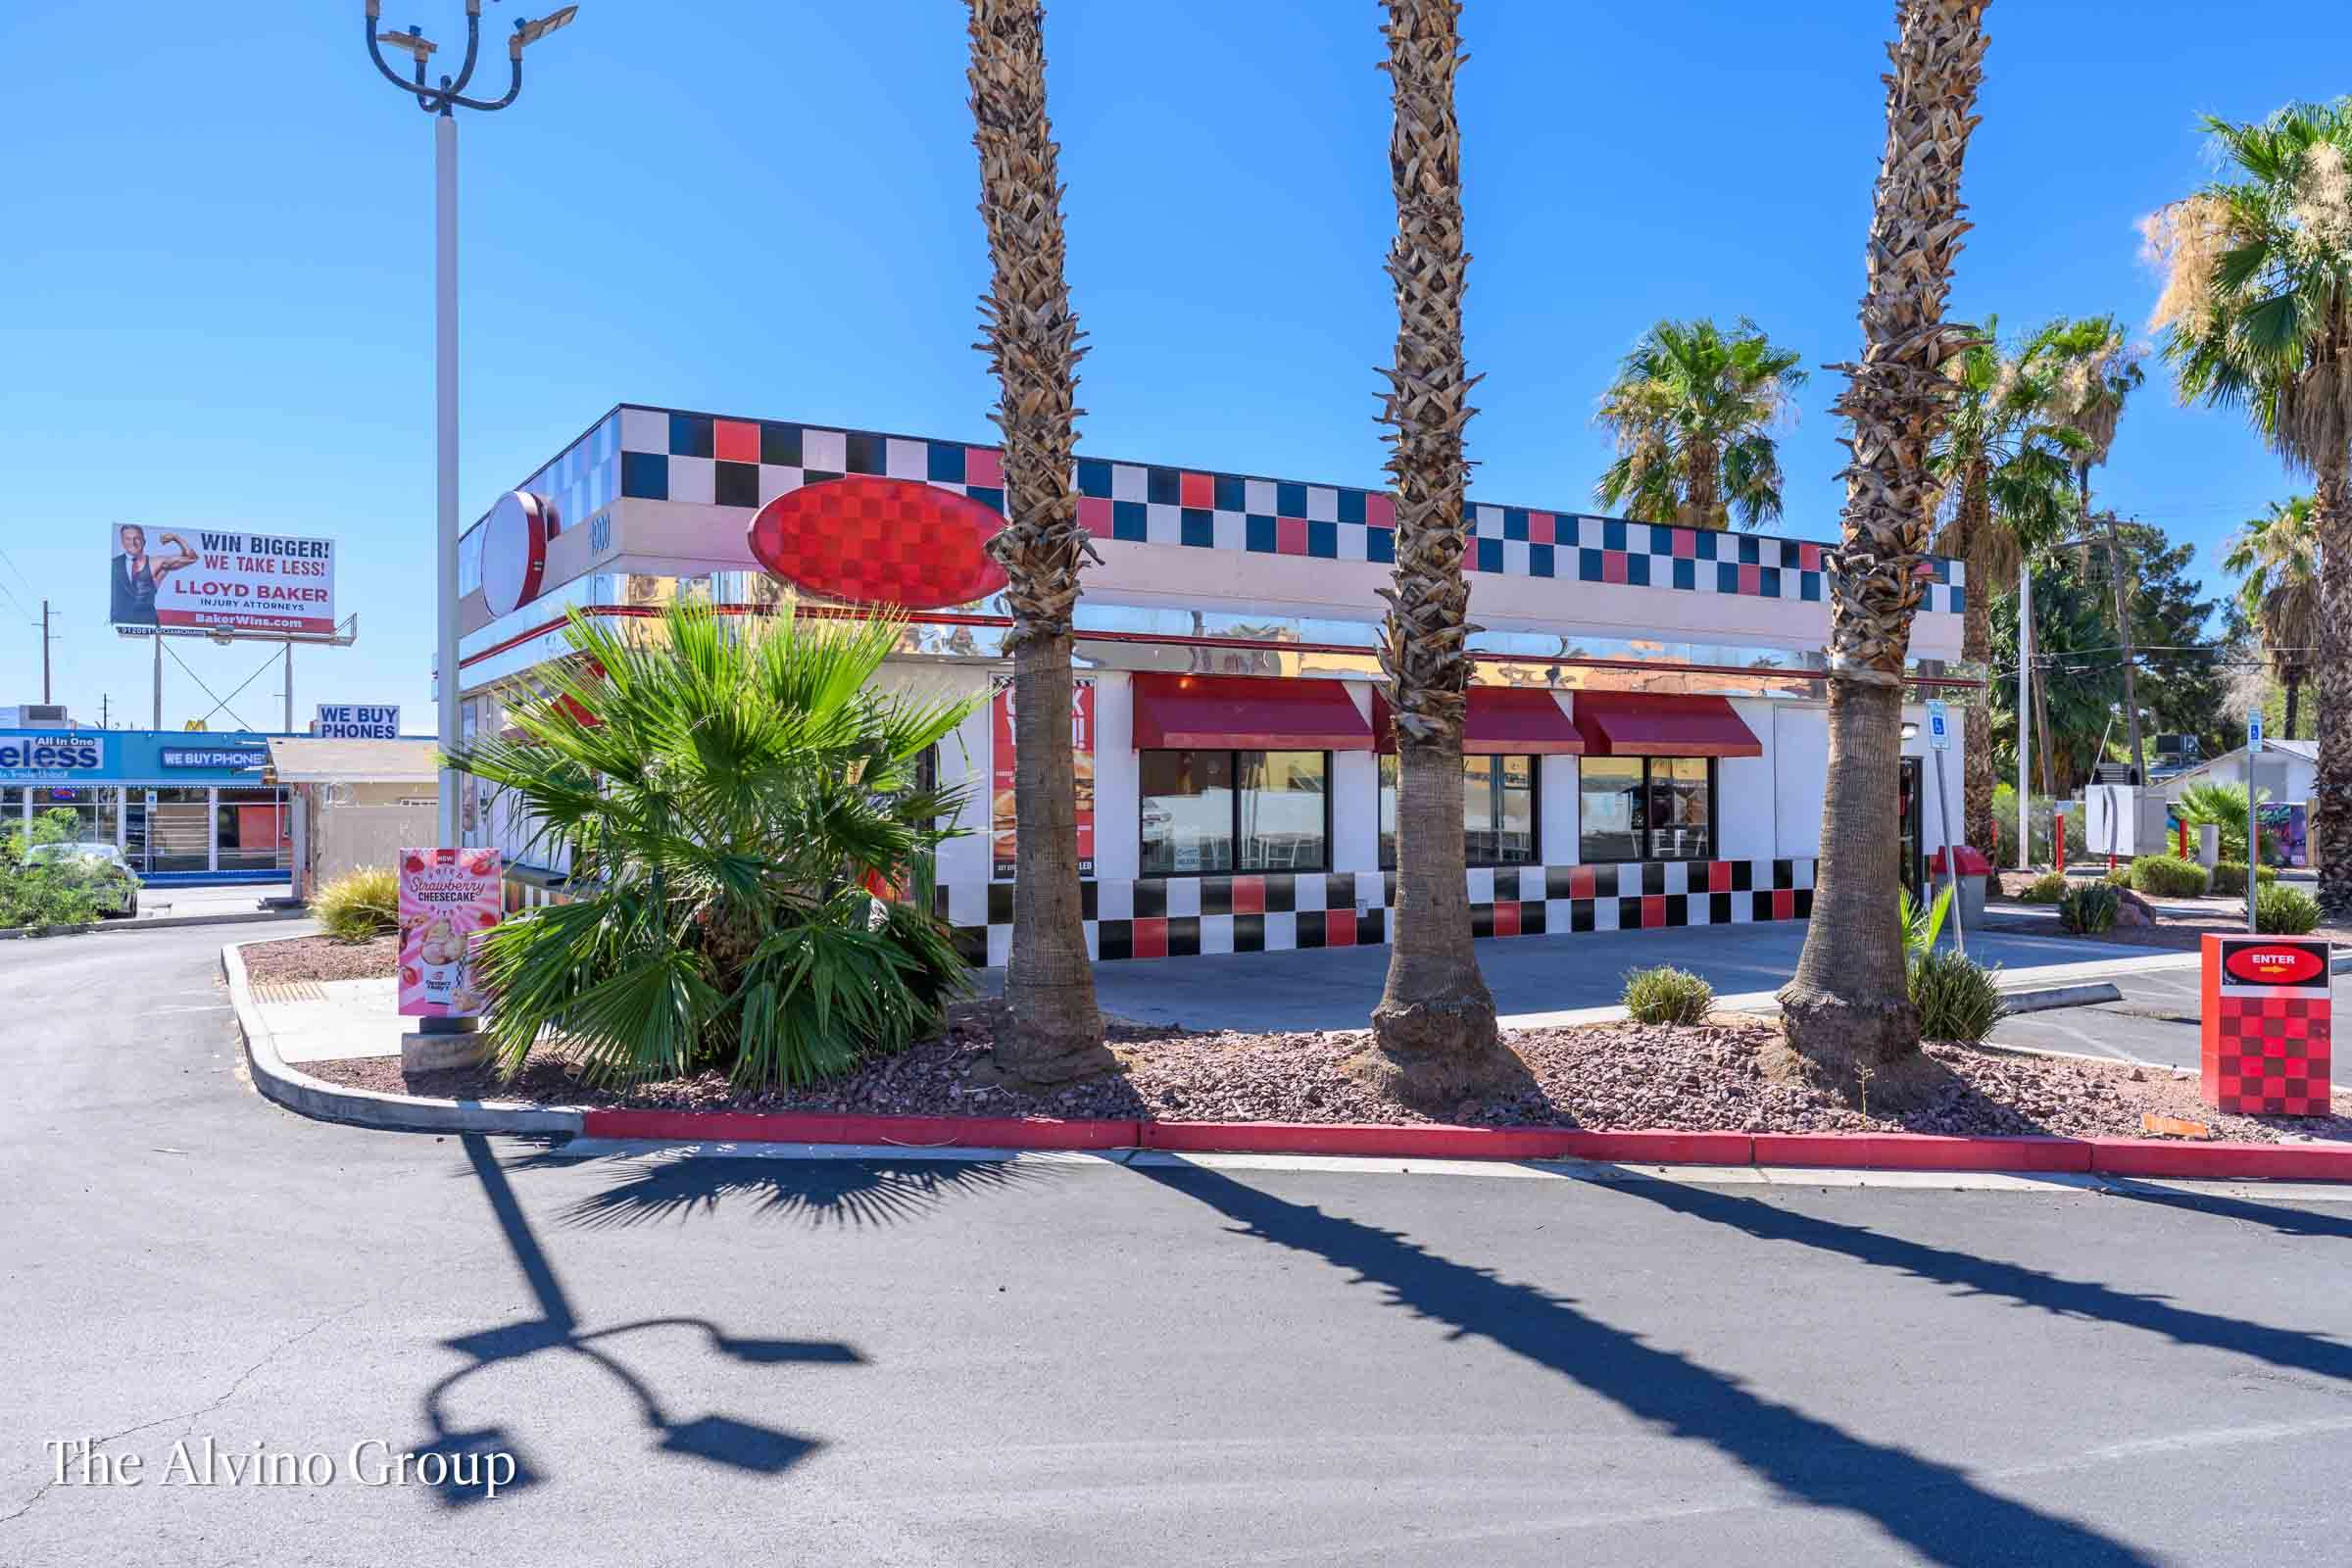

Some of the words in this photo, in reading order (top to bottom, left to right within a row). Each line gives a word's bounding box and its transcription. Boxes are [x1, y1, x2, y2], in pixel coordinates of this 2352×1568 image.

[201, 532, 241, 553] WIN
[250, 536, 330, 559] BIGGER!
[204, 555, 229, 570] WE
[236, 556, 275, 573] TAKE
[281, 560, 325, 577] LESS!
[174, 579, 250, 598] LLOYD
[257, 585, 328, 603] BAKER
[200, 598, 238, 609] INJURY
[243, 600, 305, 612] ATTORNEYS
[195, 612, 303, 628] BakerWins.com
[320, 708, 350, 723] WE
[357, 708, 397, 723] BUY
[321, 723, 396, 739] PHONES
[37, 737, 53, 746] All
[56, 737, 68, 746] In
[70, 737, 94, 746] One
[164, 753, 183, 765] WE
[185, 753, 212, 765] BUY
[410, 876, 486, 897] Strawberry
[418, 892, 476, 903] CHEESECAKE
[2252, 954, 2296, 964] ENTER
